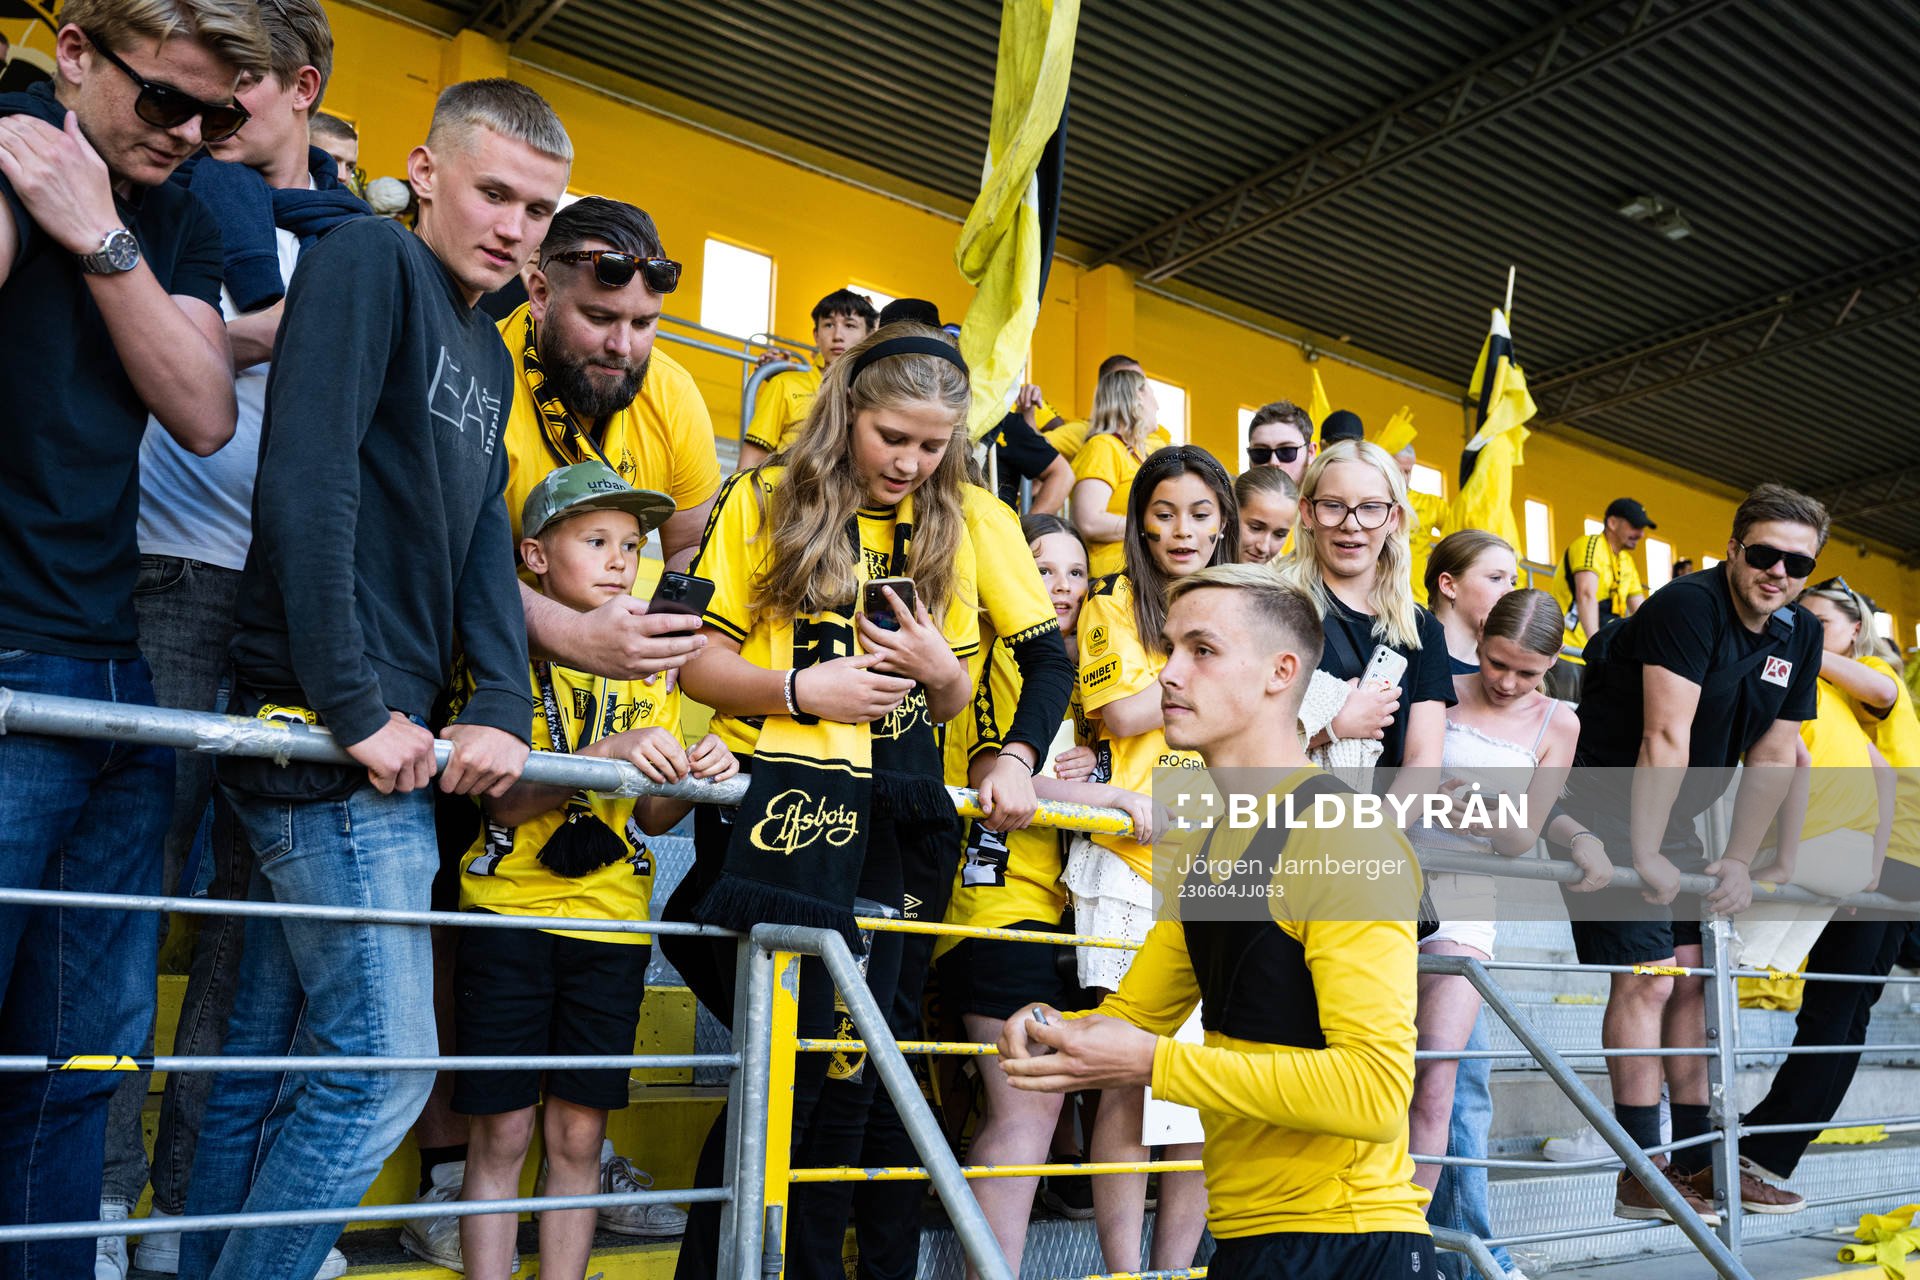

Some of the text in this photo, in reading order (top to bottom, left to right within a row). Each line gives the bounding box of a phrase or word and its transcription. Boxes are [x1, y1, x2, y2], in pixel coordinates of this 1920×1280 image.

[587, 478, 626, 491] urban
[1082, 660, 1117, 684] UNIBET
[750, 788, 859, 856] Elfsborg
